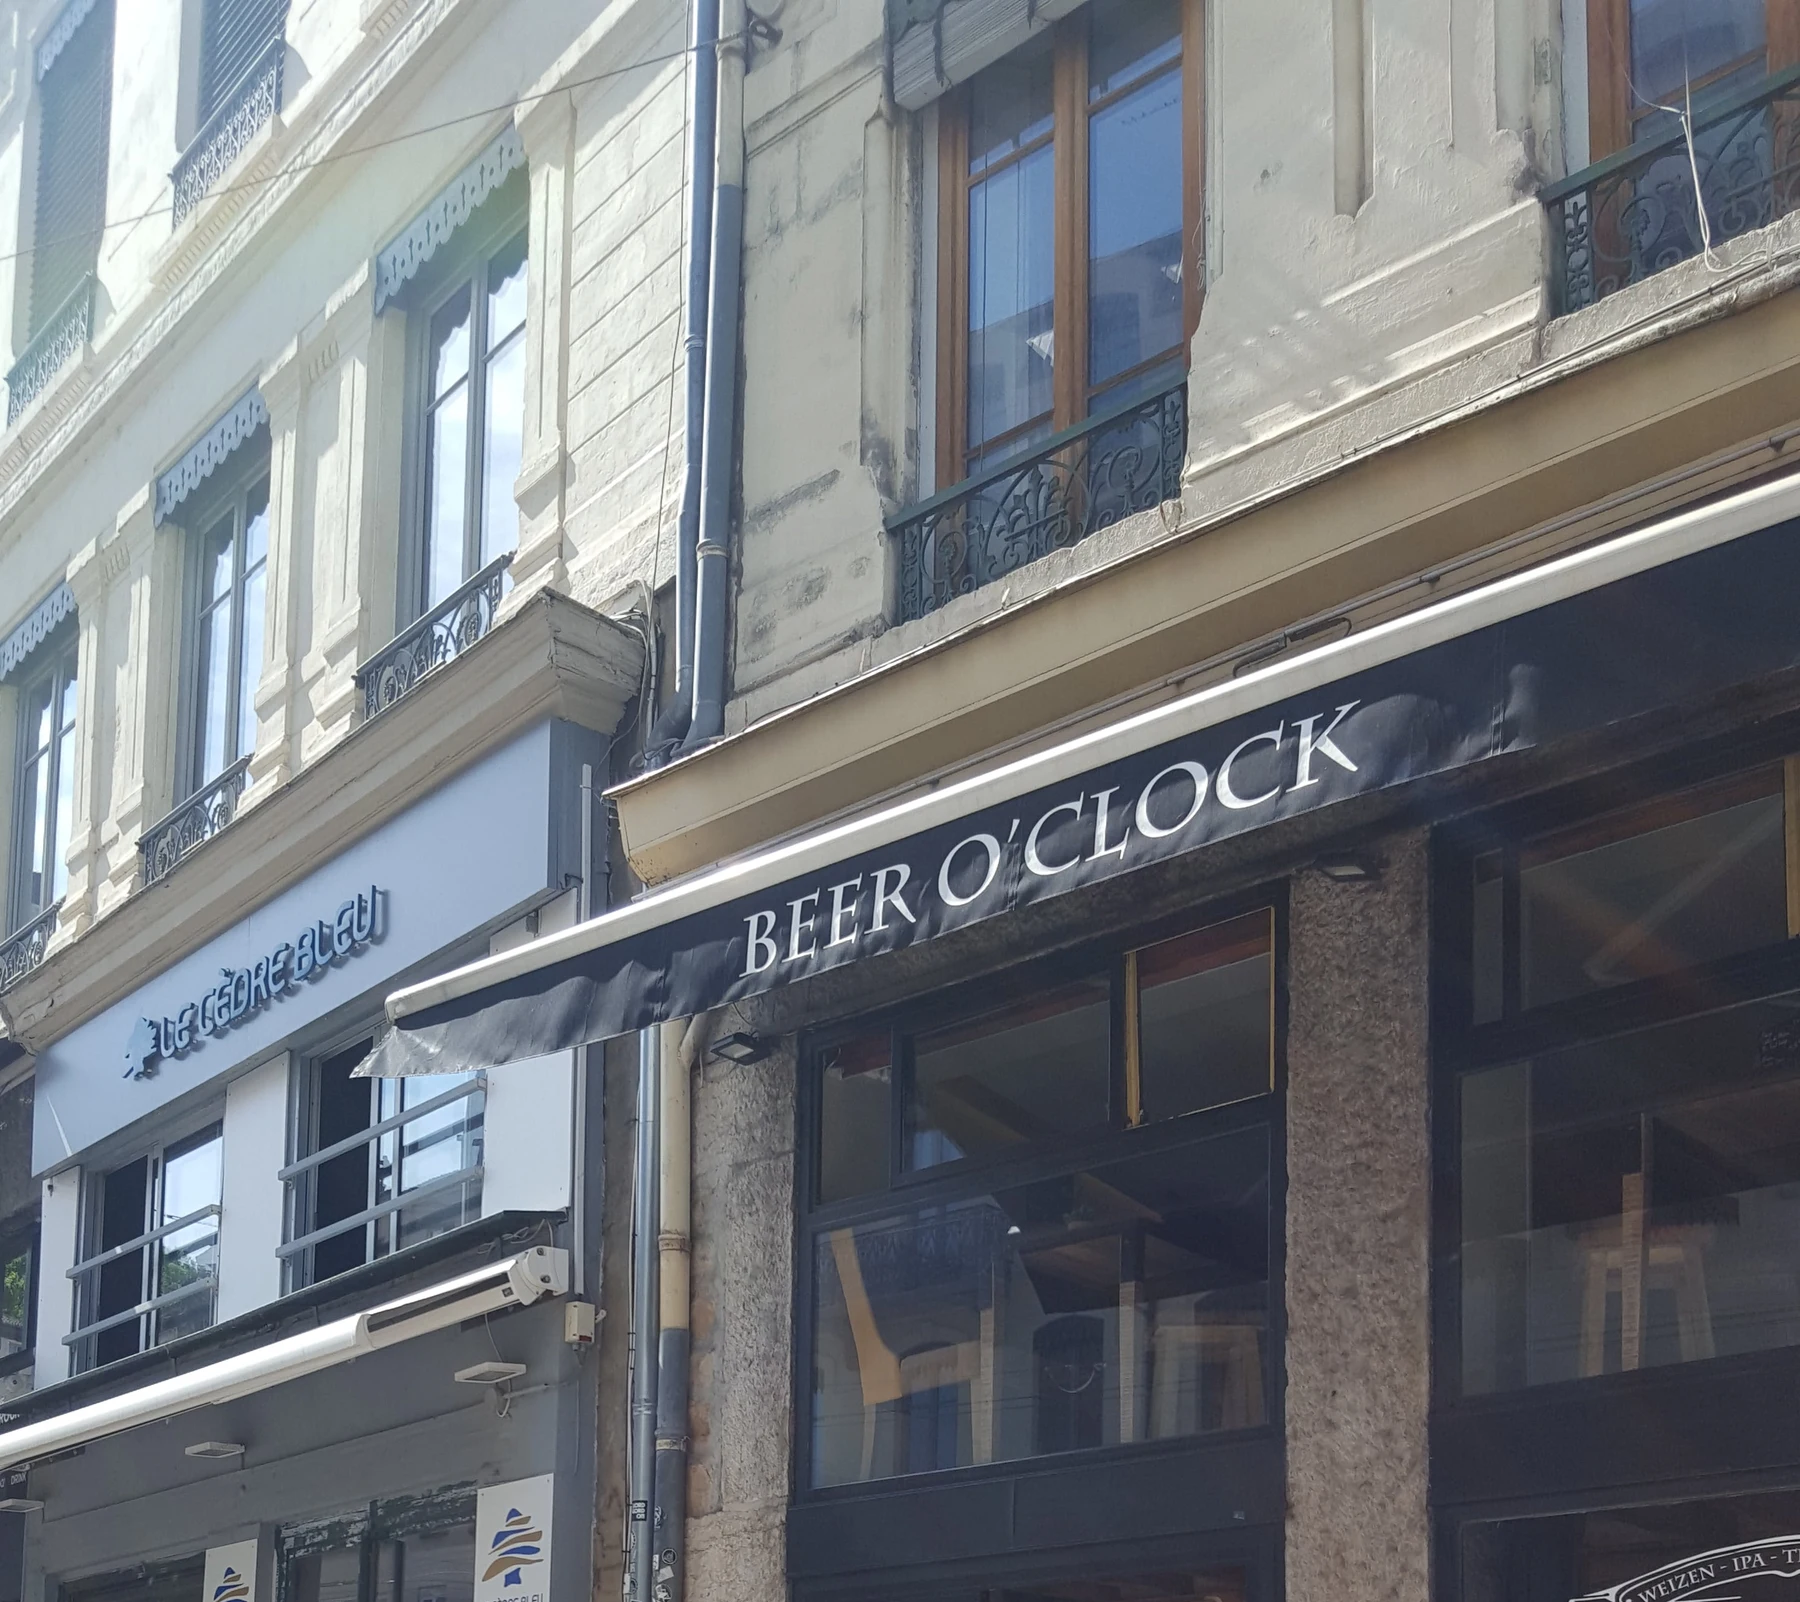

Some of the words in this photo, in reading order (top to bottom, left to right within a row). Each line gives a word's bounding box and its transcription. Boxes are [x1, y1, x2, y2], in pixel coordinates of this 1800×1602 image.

[739, 864, 916, 978] BEER
[938, 700, 1361, 906] O'CLOCK
[160, 1002, 197, 1057] LE
[199, 943, 290, 1036] CÈDRE
[294, 885, 378, 981] BLEU
[1732, 1553, 1767, 1572] IPA
[1782, 1548, 1800, 1564] T
